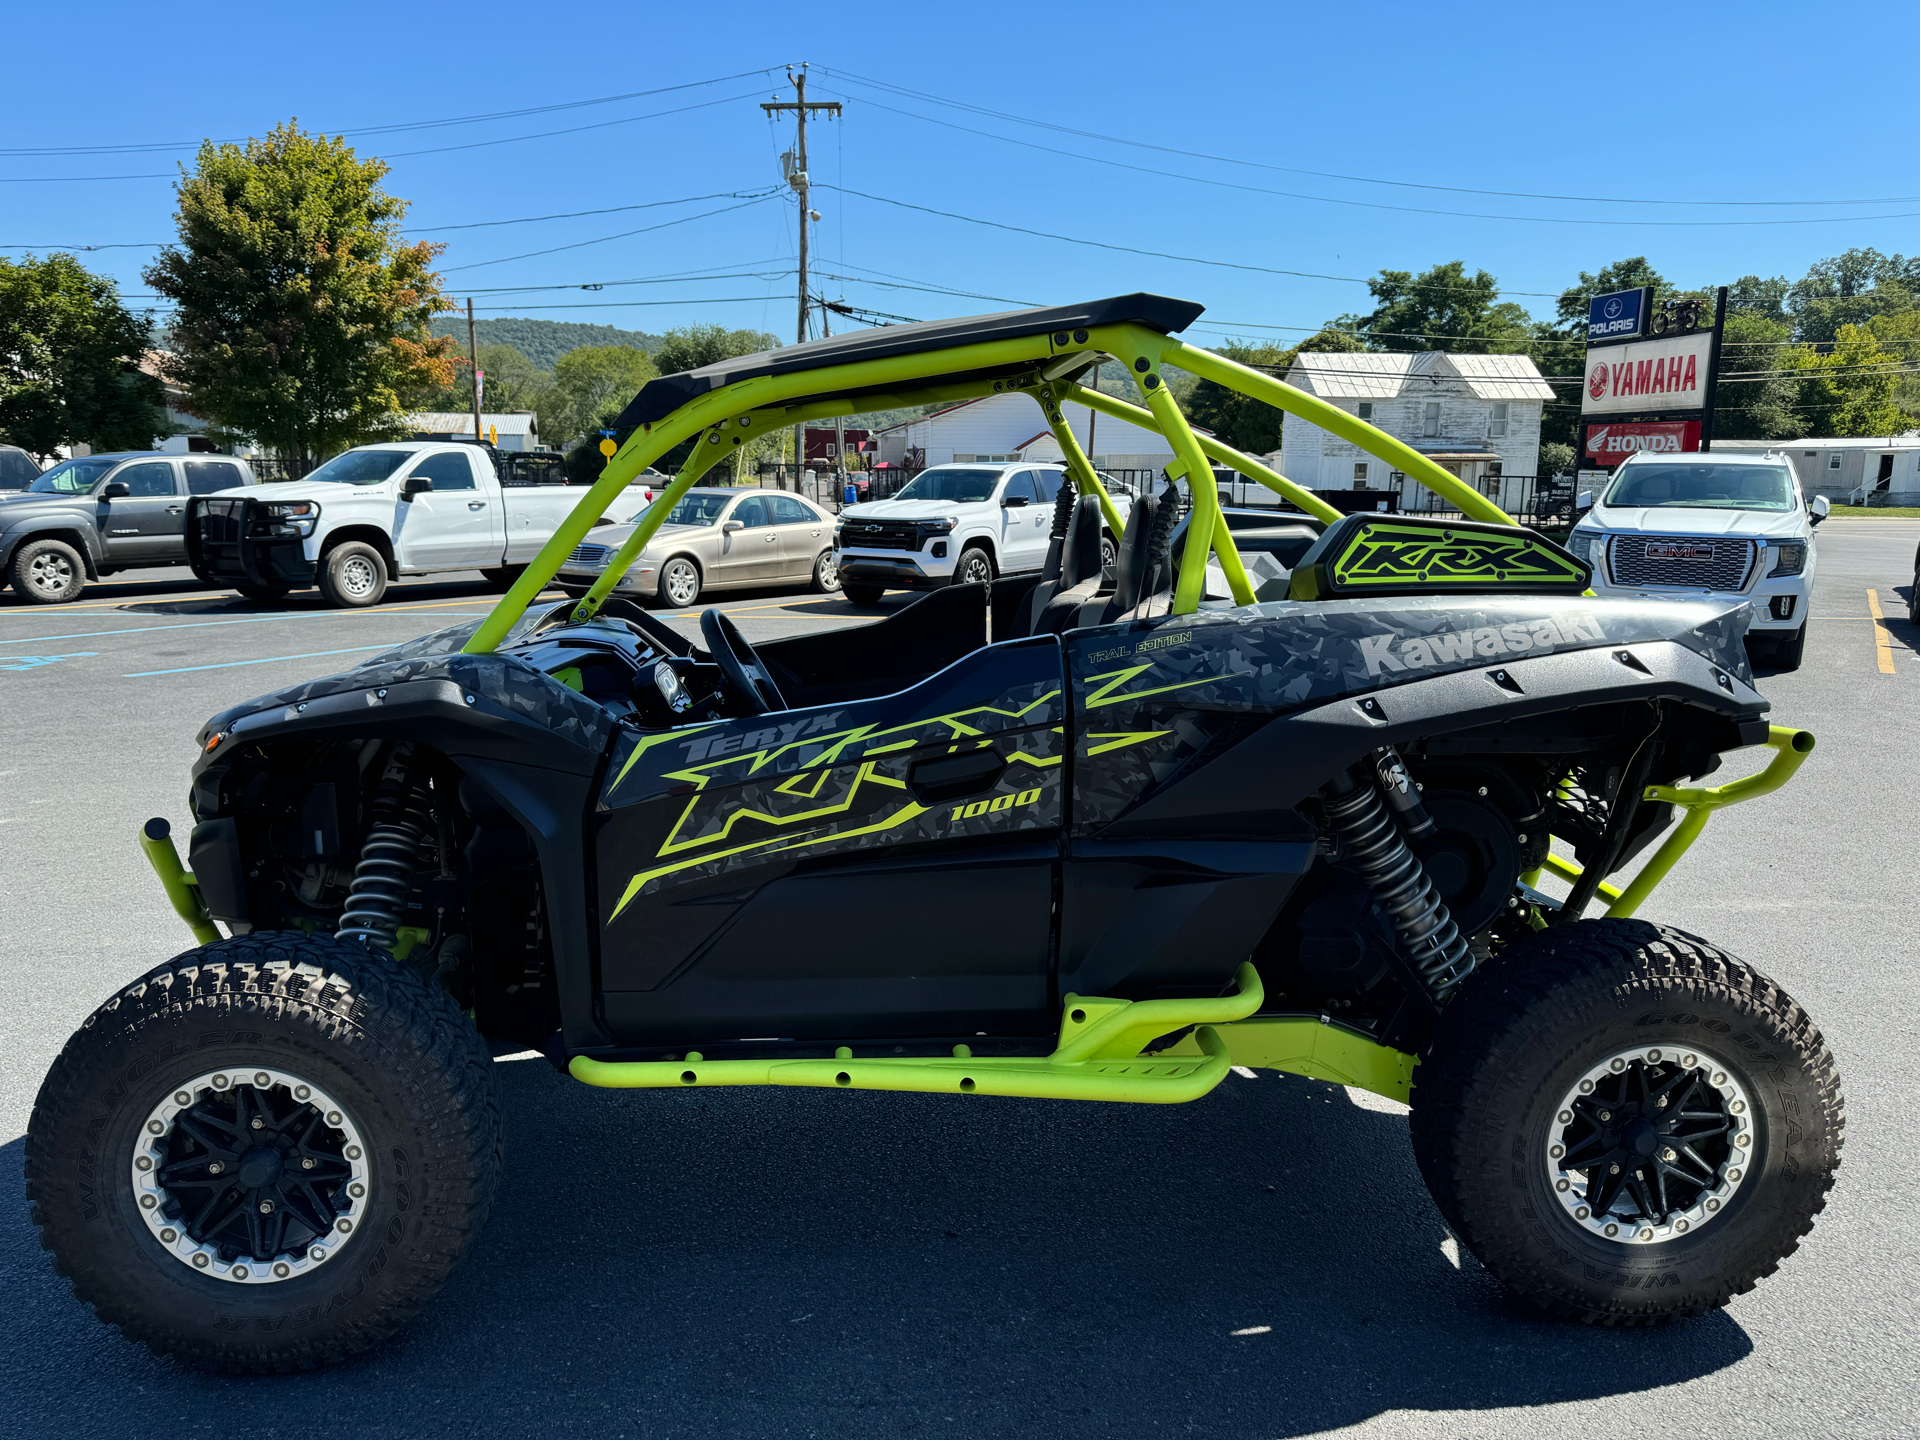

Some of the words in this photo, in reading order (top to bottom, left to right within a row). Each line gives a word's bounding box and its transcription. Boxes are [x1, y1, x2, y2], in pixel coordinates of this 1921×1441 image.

[1588, 317, 1635, 336] POLARIS
[1612, 354, 1696, 397] YAMAHA
[1607, 435, 1681, 452] HONDA
[1347, 540, 1550, 575] KRX
[1648, 545, 1712, 559] GMC
[1087, 645, 1131, 664] TRAIL
[1135, 631, 1192, 653] EDITION
[1358, 609, 1608, 677] Kawasaki
[678, 710, 849, 764] TERYX
[951, 788, 1042, 822] 1000
[1634, 1011, 1804, 1184] GOODYEAR
[77, 1029, 266, 1222] WRANGLER
[1512, 1133, 1682, 1292] WRANGLER
[211, 1147, 412, 1335] GOODYEAR
